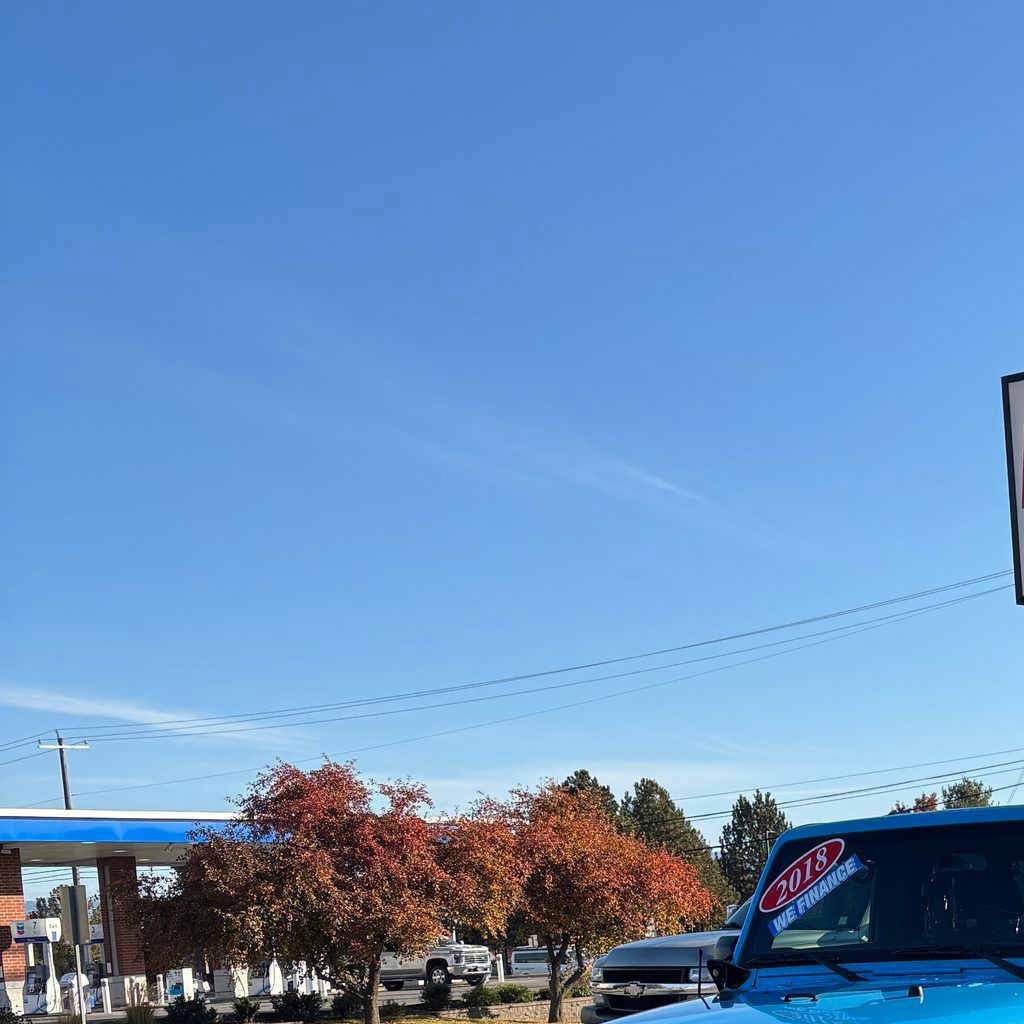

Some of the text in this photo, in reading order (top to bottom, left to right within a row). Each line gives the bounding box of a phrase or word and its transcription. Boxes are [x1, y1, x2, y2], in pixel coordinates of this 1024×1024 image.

[772, 857, 858, 934] WE FINANCE
[775, 846, 828, 907] 2018
